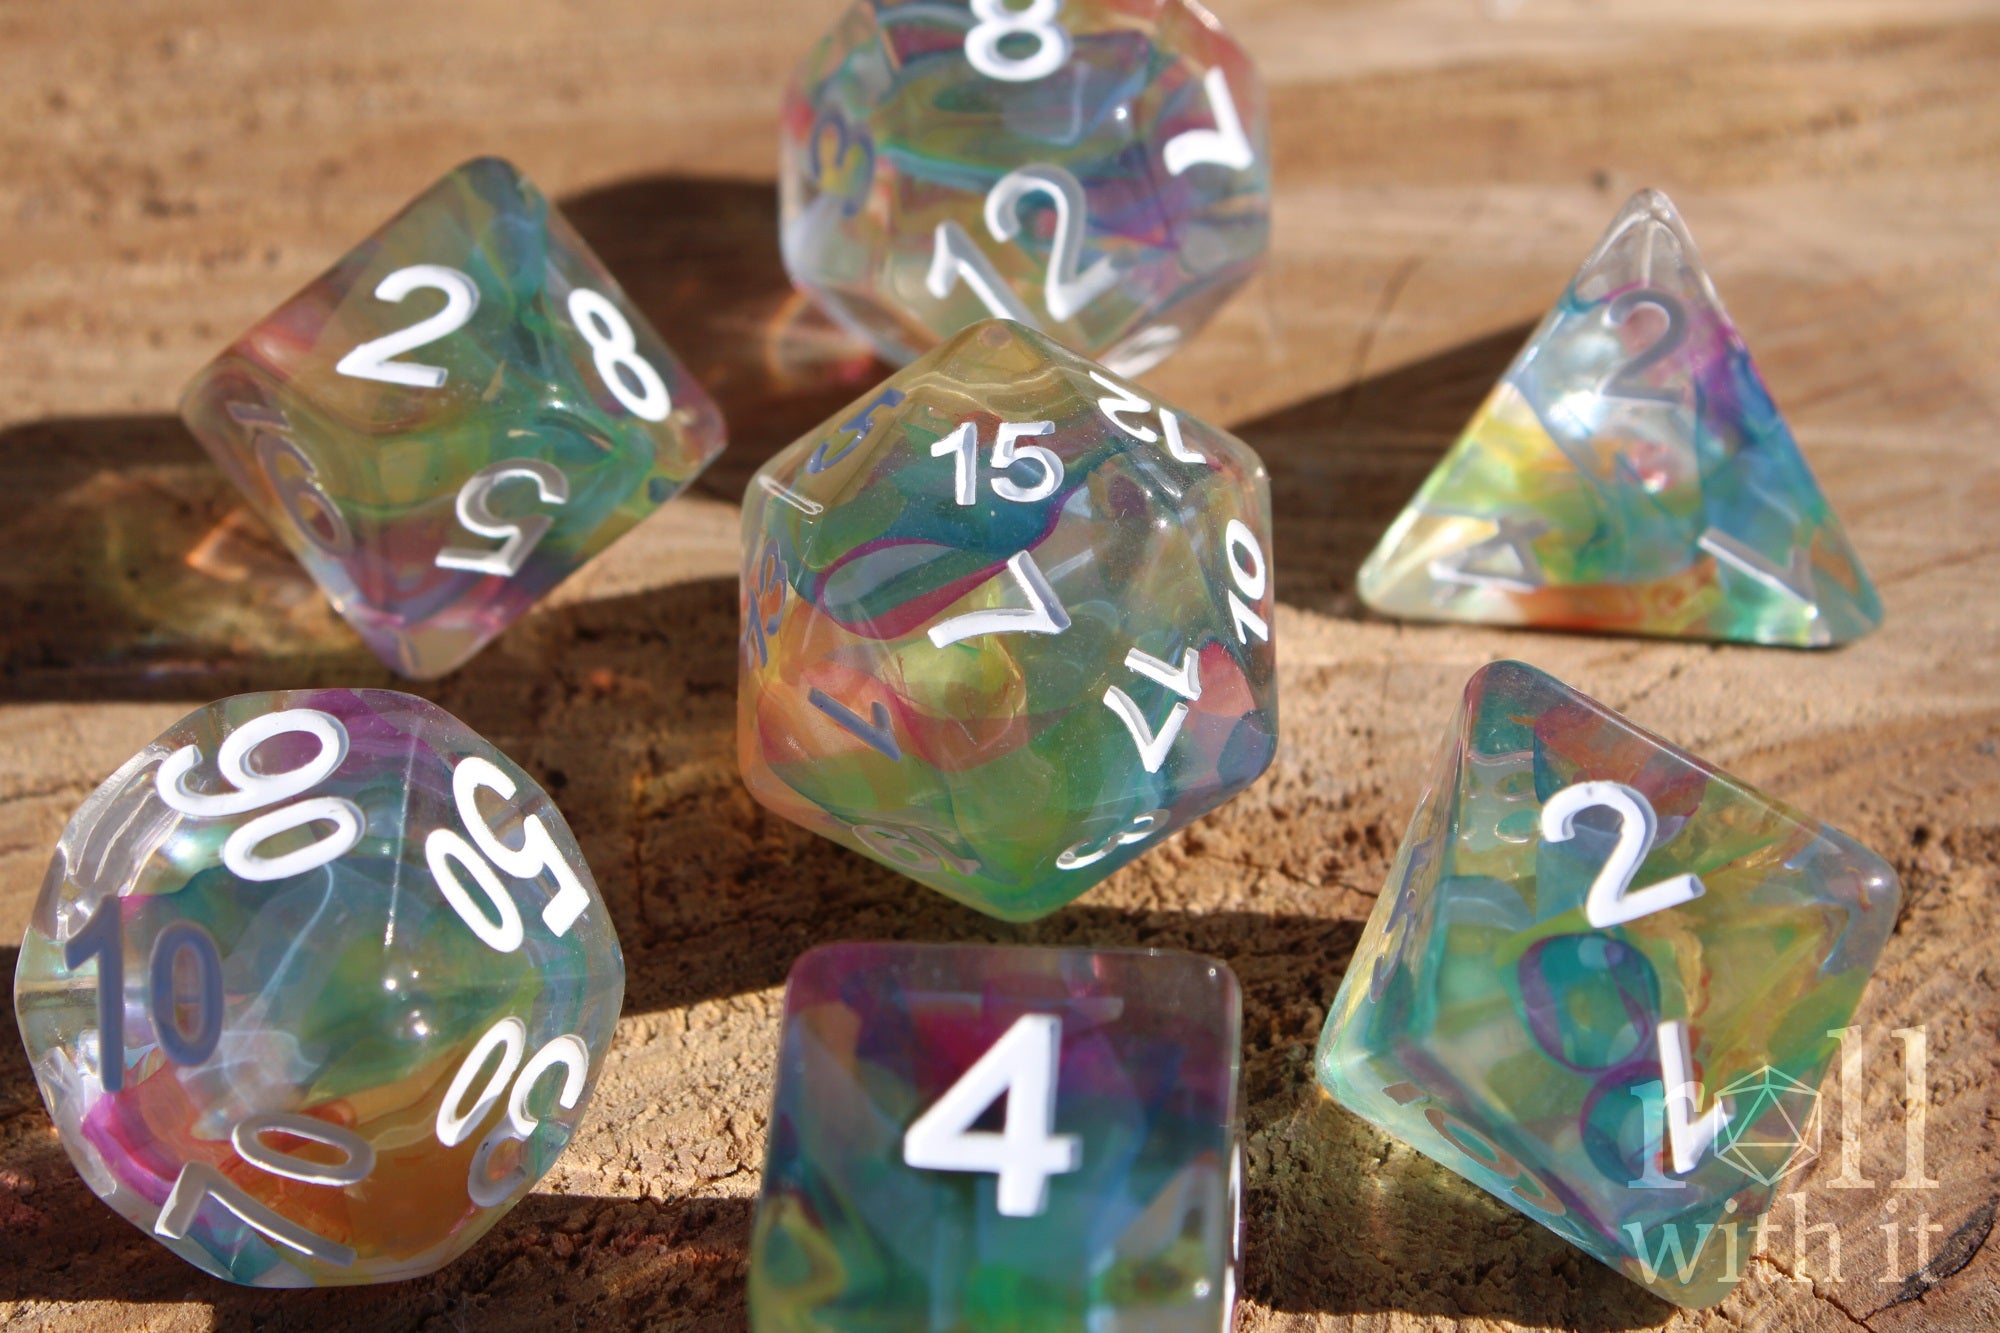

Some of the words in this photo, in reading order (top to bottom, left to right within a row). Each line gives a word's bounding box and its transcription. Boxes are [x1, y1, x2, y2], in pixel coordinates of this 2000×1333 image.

[965, 0, 1071, 81] 8
[926, 163, 1128, 332] 12
[336, 264, 480, 388] 2
[568, 288, 671, 422] 8
[1602, 289, 1689, 405] 2
[435, 457, 569, 577] 5
[931, 420, 1065, 506] 15
[927, 549, 1073, 649] 7
[1225, 518, 1269, 645] 10
[156, 708, 366, 882] 90
[425, 756, 590, 953] 50
[1541, 781, 1706, 929] 2
[65, 893, 224, 1093] 10
[904, 1013, 1081, 1218] 4
